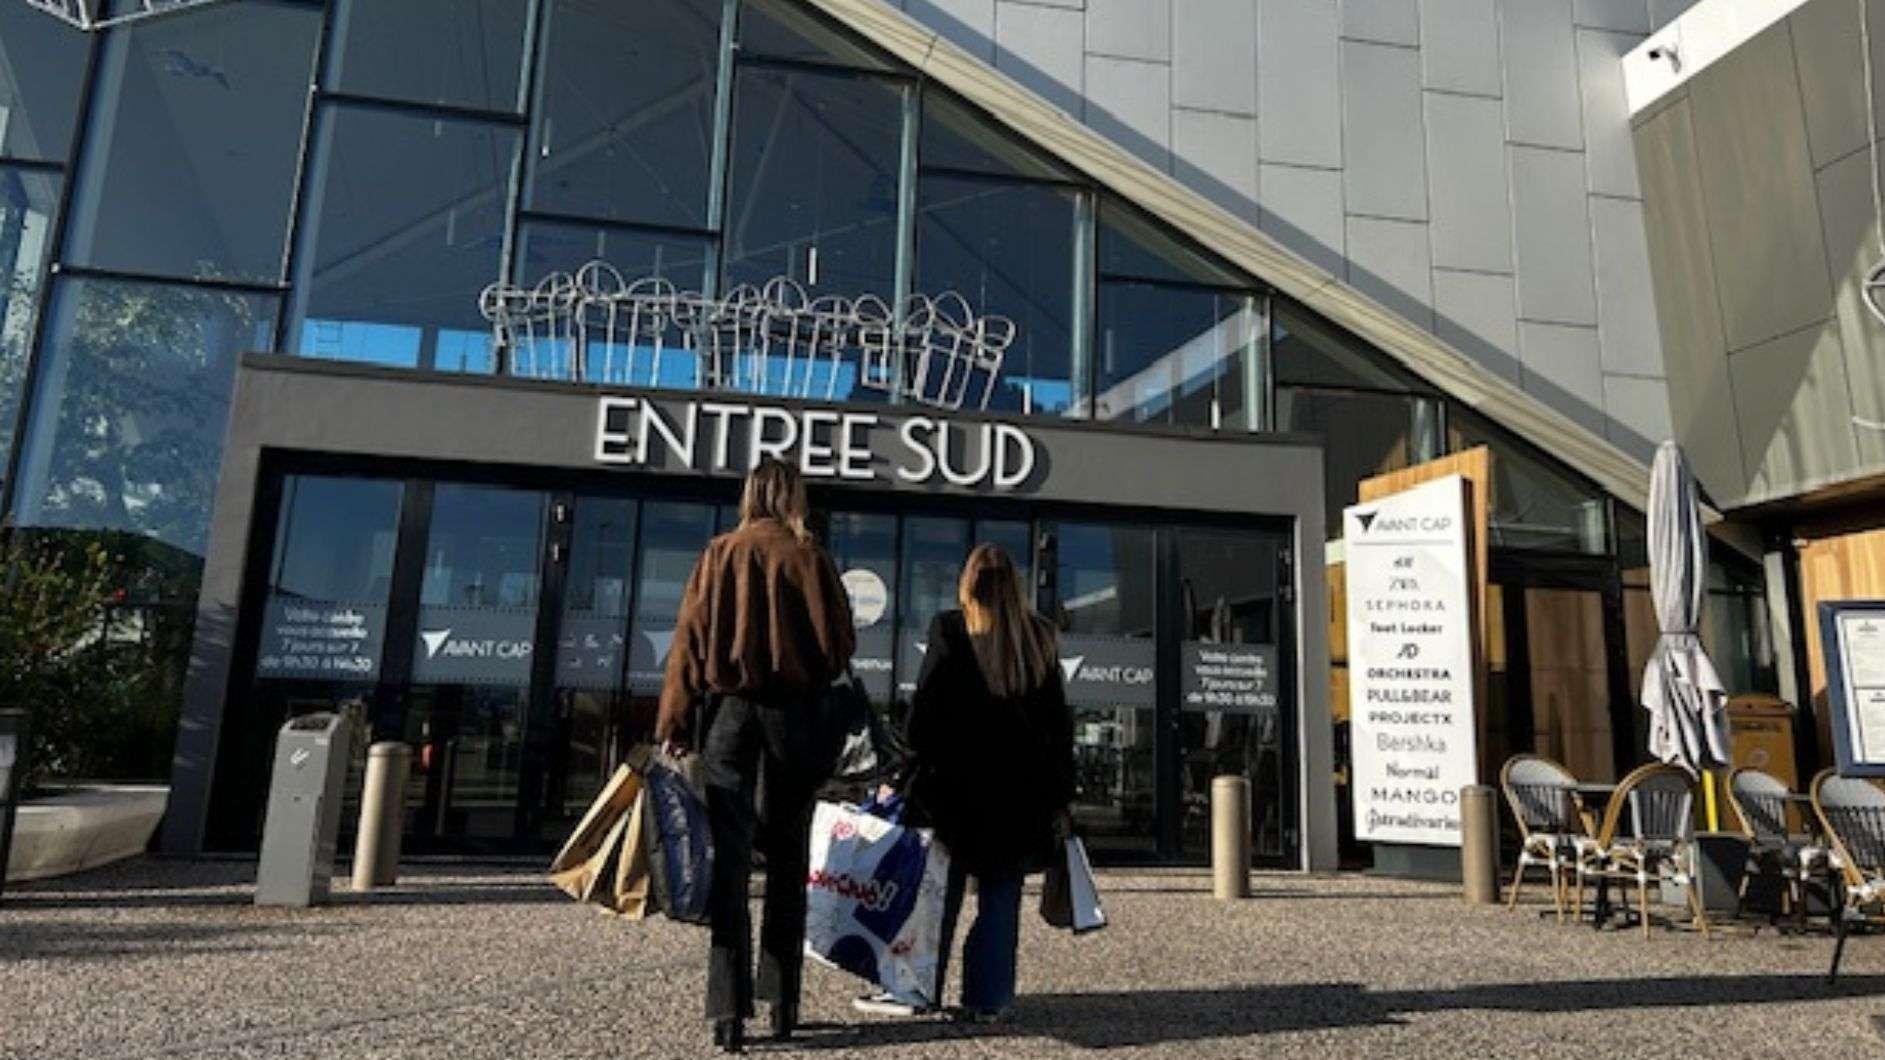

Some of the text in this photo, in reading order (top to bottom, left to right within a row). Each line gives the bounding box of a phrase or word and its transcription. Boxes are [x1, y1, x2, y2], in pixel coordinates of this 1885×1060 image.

[594, 397, 1034, 488] ENTREE SUD
[1376, 518, 1452, 532] AVANT CAP
[1366, 599, 1446, 611] SEPHORA
[1370, 623, 1443, 634] Foot Locker
[445, 640, 531, 658] AVANT CAP
[1079, 665, 1153, 683] AVANT CAP
[1367, 668, 1452, 680] ORCHESTRA
[1367, 689, 1452, 702] PULL&BEAR
[1376, 733, 1447, 753] Bershka
[1371, 787, 1457, 804] MANGO
